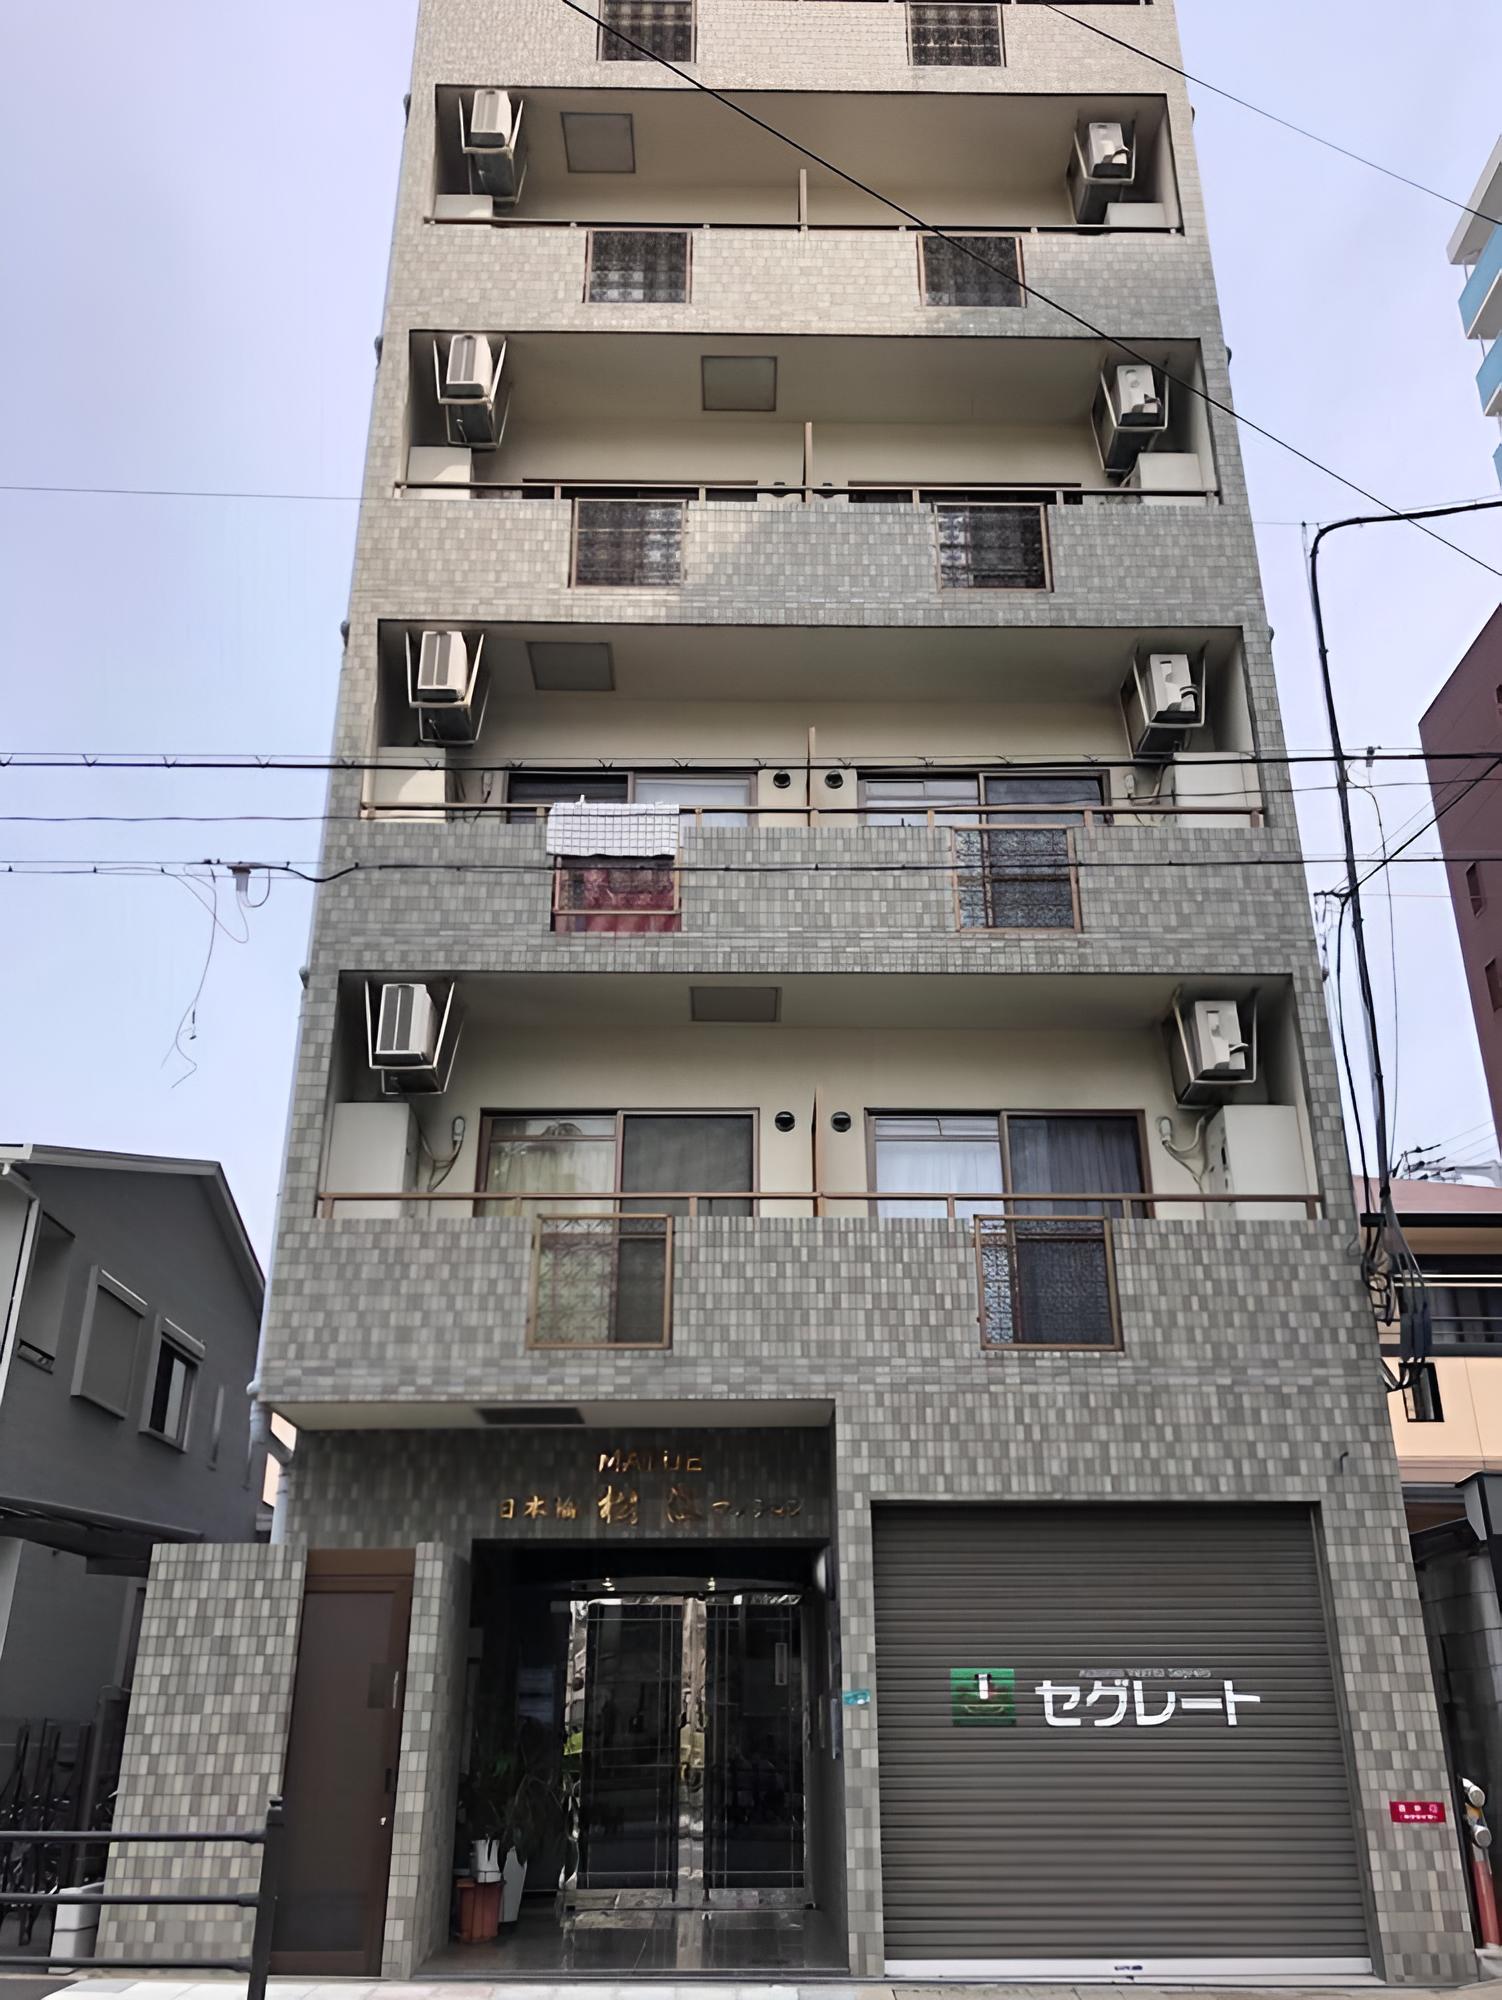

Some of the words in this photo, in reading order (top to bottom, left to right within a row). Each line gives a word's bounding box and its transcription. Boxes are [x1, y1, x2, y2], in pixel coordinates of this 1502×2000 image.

[1035, 1679, 1261, 1726] セグレート
